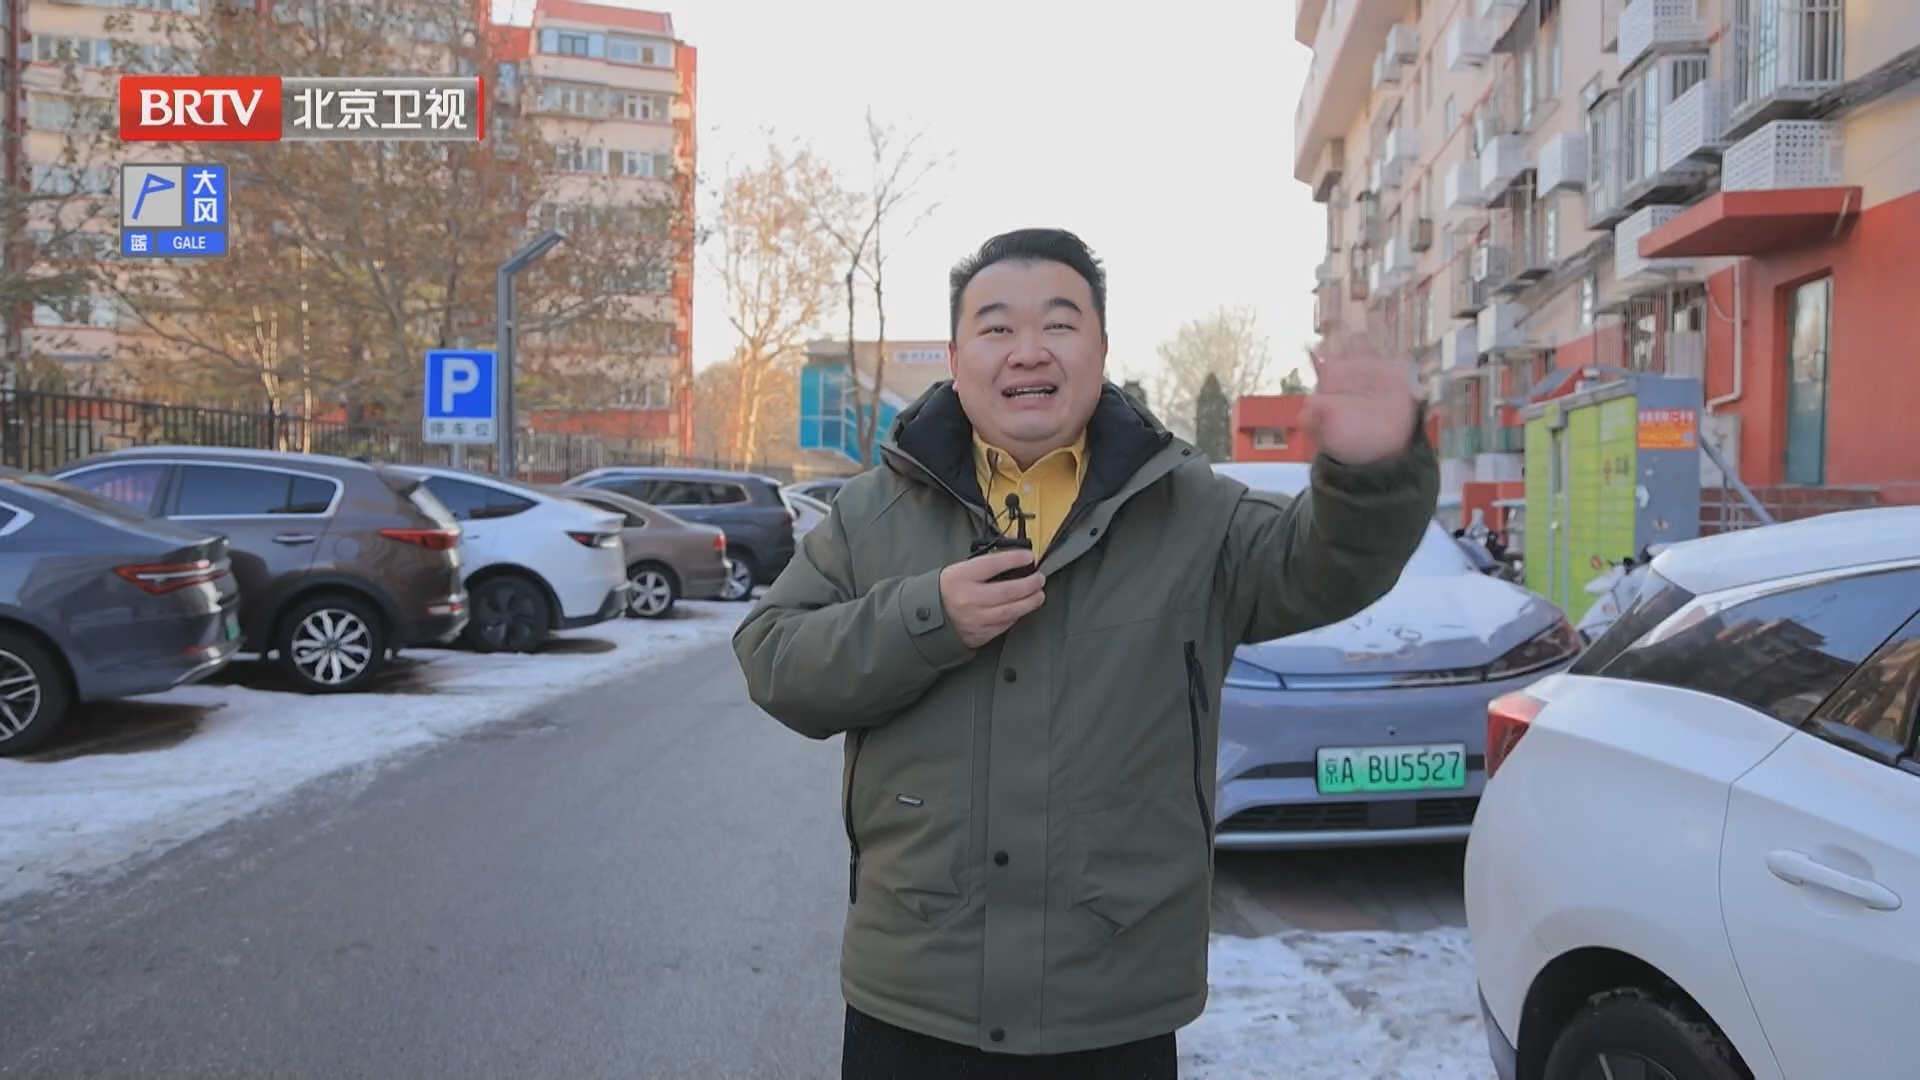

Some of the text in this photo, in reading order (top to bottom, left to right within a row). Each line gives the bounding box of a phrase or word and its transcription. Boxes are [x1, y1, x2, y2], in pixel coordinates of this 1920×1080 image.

[441, 357, 481, 413] P
[429, 421, 490, 437] 停车位
[1368, 750, 1461, 784] BU5527
